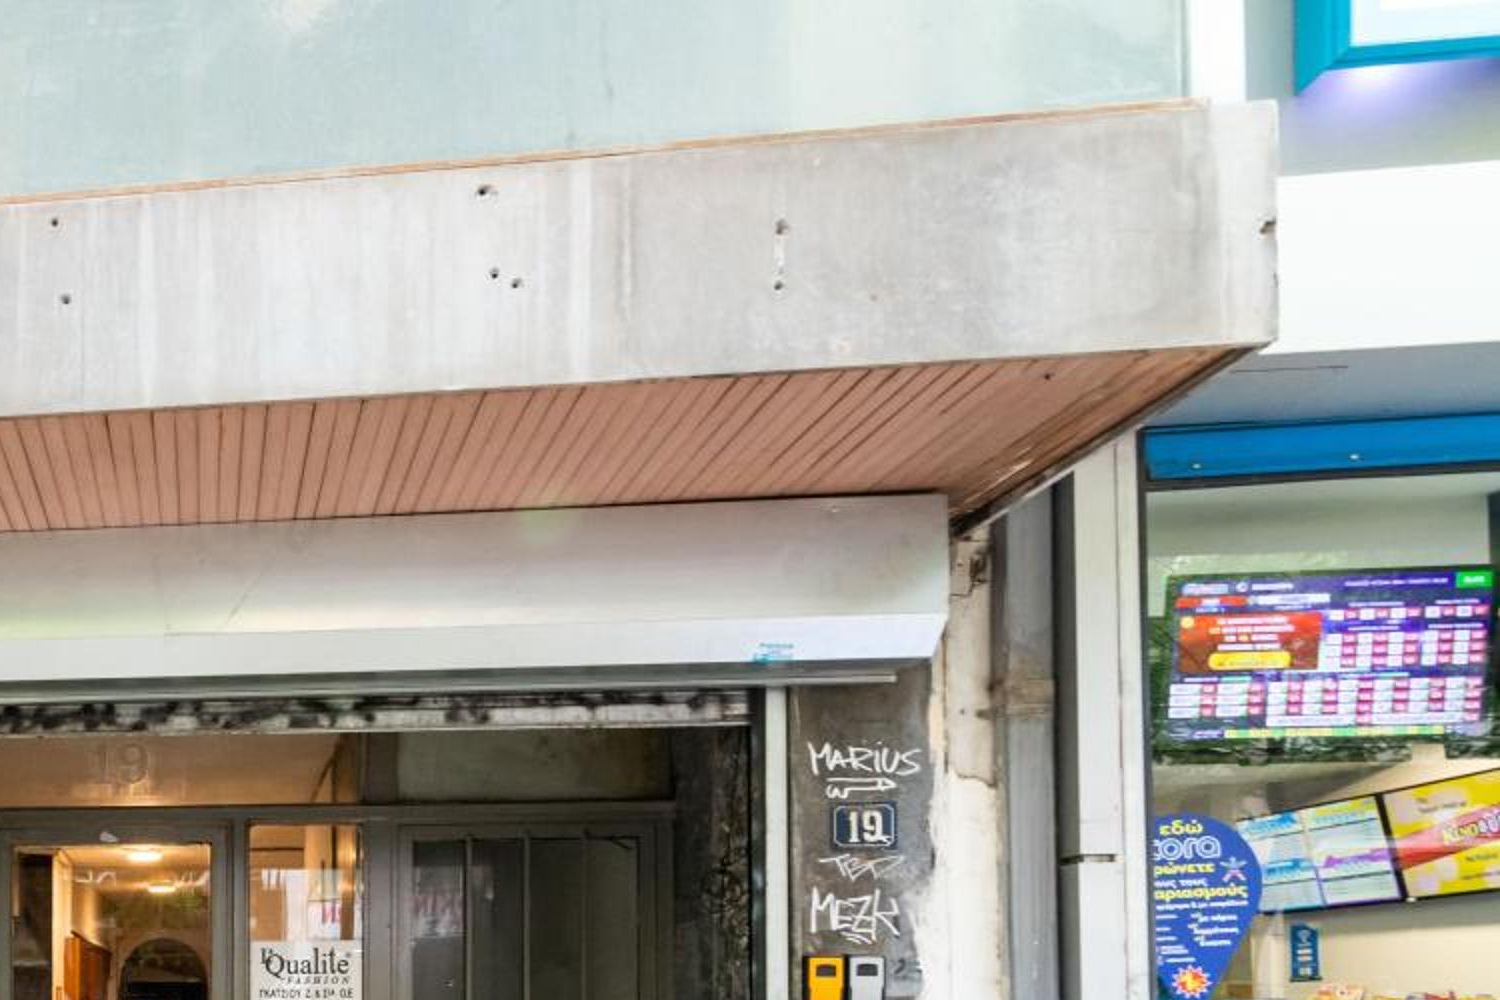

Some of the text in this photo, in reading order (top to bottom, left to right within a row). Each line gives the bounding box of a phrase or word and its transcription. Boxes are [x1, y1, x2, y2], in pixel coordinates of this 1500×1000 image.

[807, 741, 922, 776] MARIUS
[847, 809, 885, 844] 19
[1159, 819, 1203, 836] εδώ
[287, 975, 350, 985] FASHION
